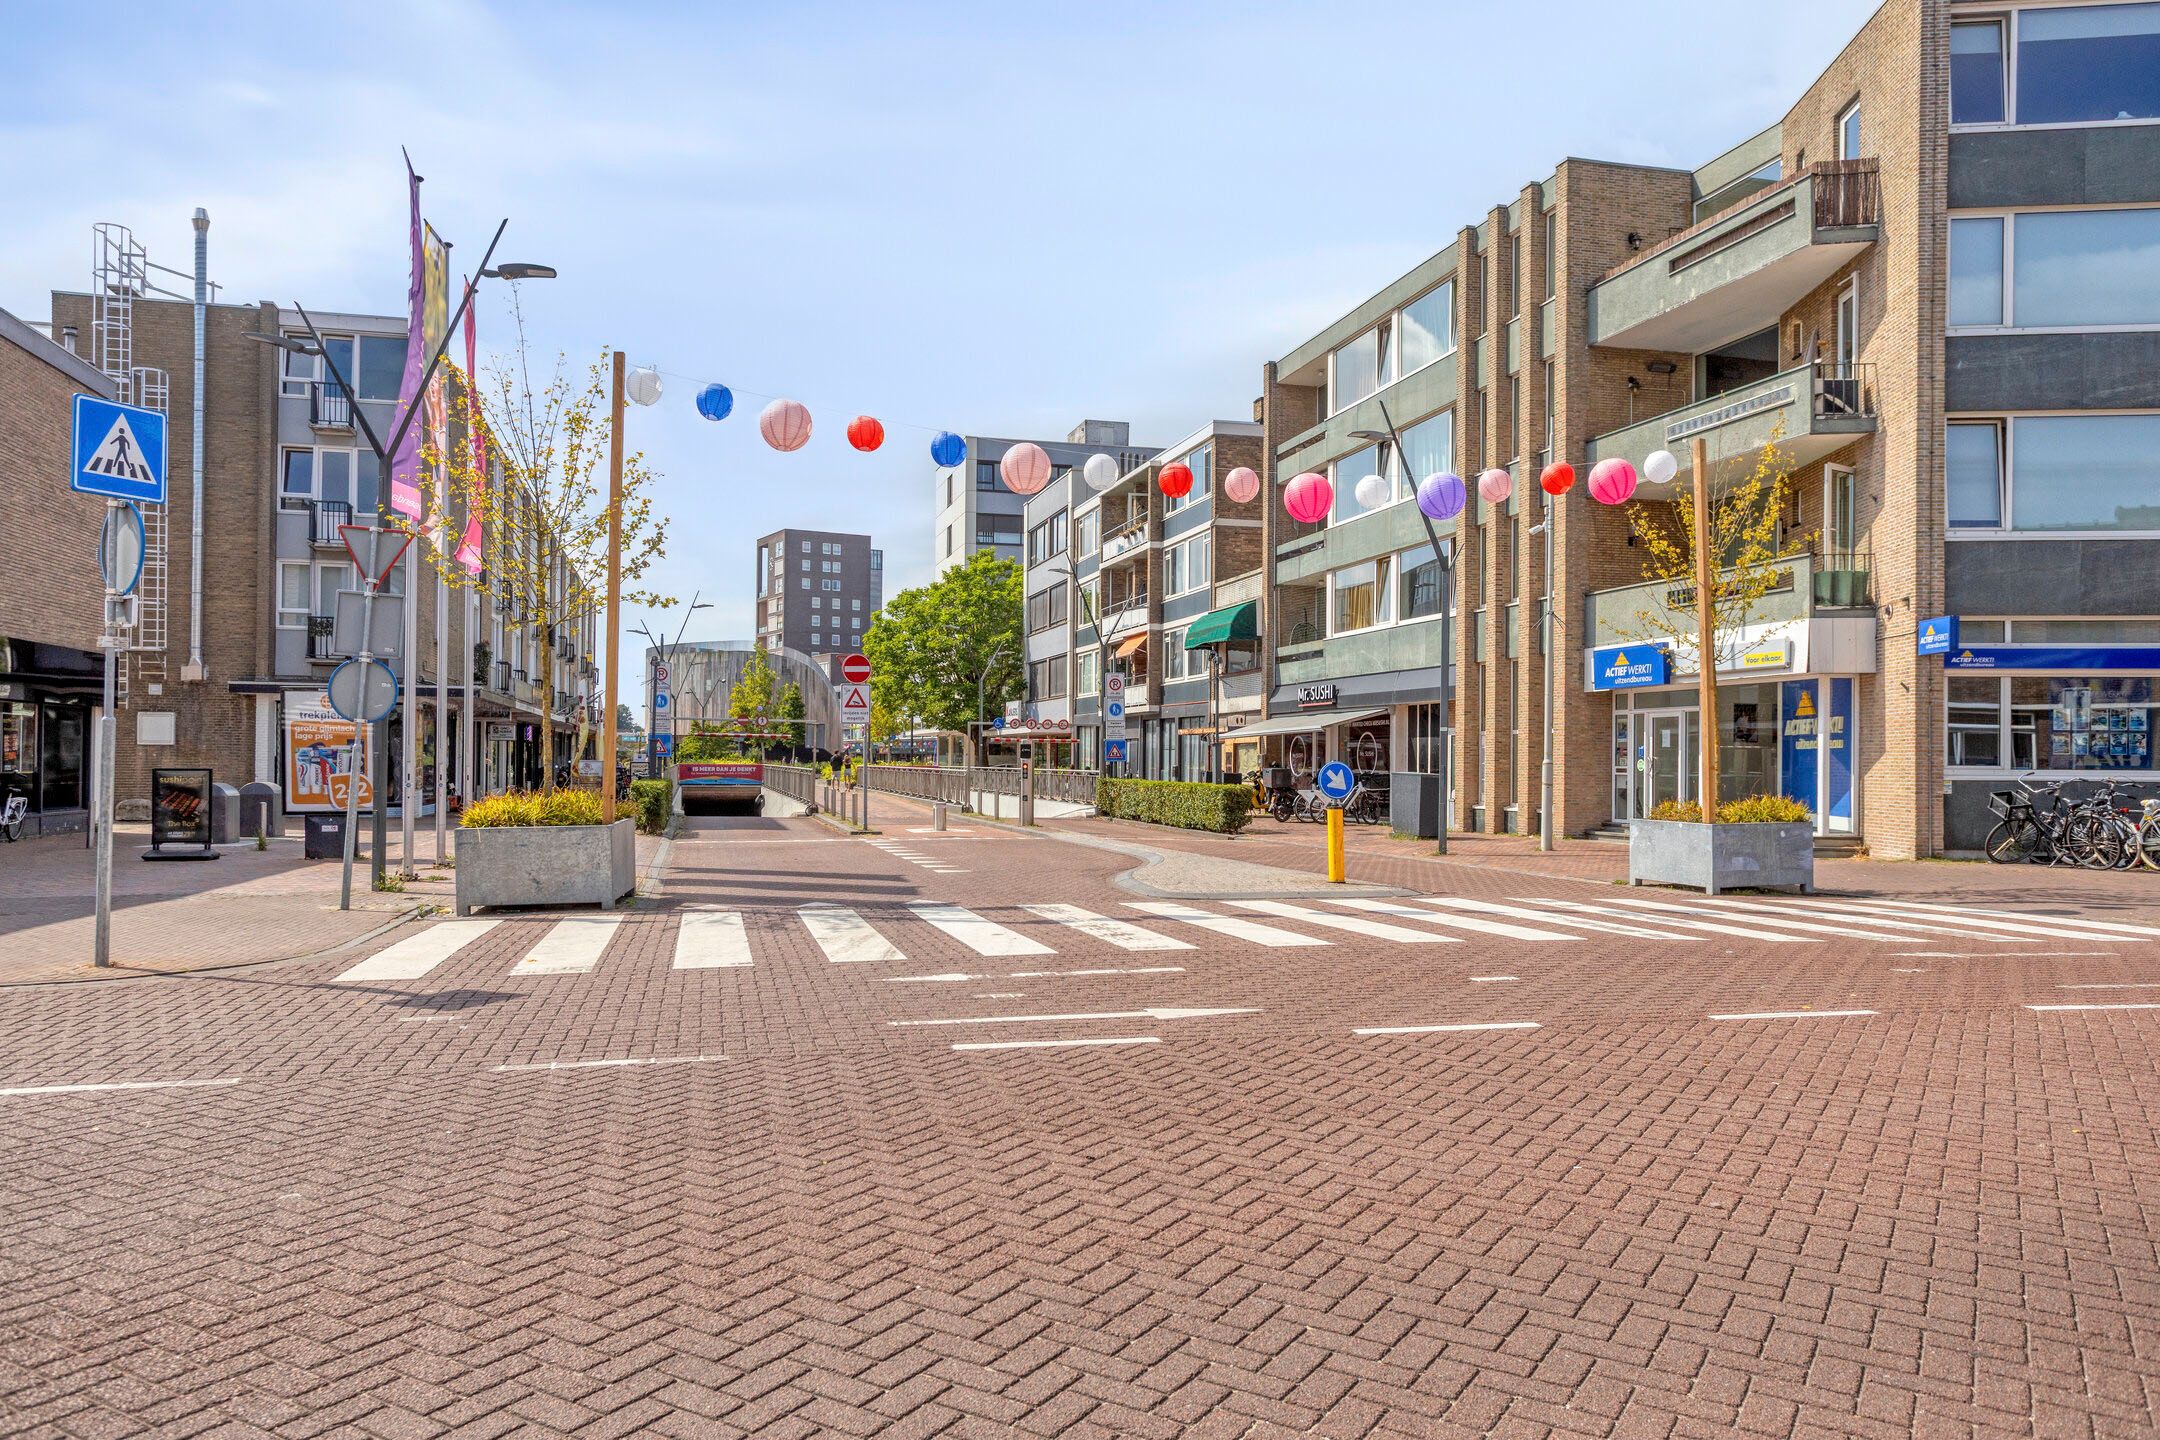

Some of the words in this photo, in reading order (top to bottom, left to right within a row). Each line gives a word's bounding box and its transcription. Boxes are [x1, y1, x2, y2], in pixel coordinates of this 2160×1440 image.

[1920, 635, 1934, 644] ACTIEF
[1605, 666, 1628, 677] ACTIEF
[1615, 676, 1652, 684] uitzendbureau
[1310, 684, 1333, 700] SUSHI
[294, 724, 317, 733] grote
[294, 731, 313, 740] lage
[314, 731, 333, 741] prijs
